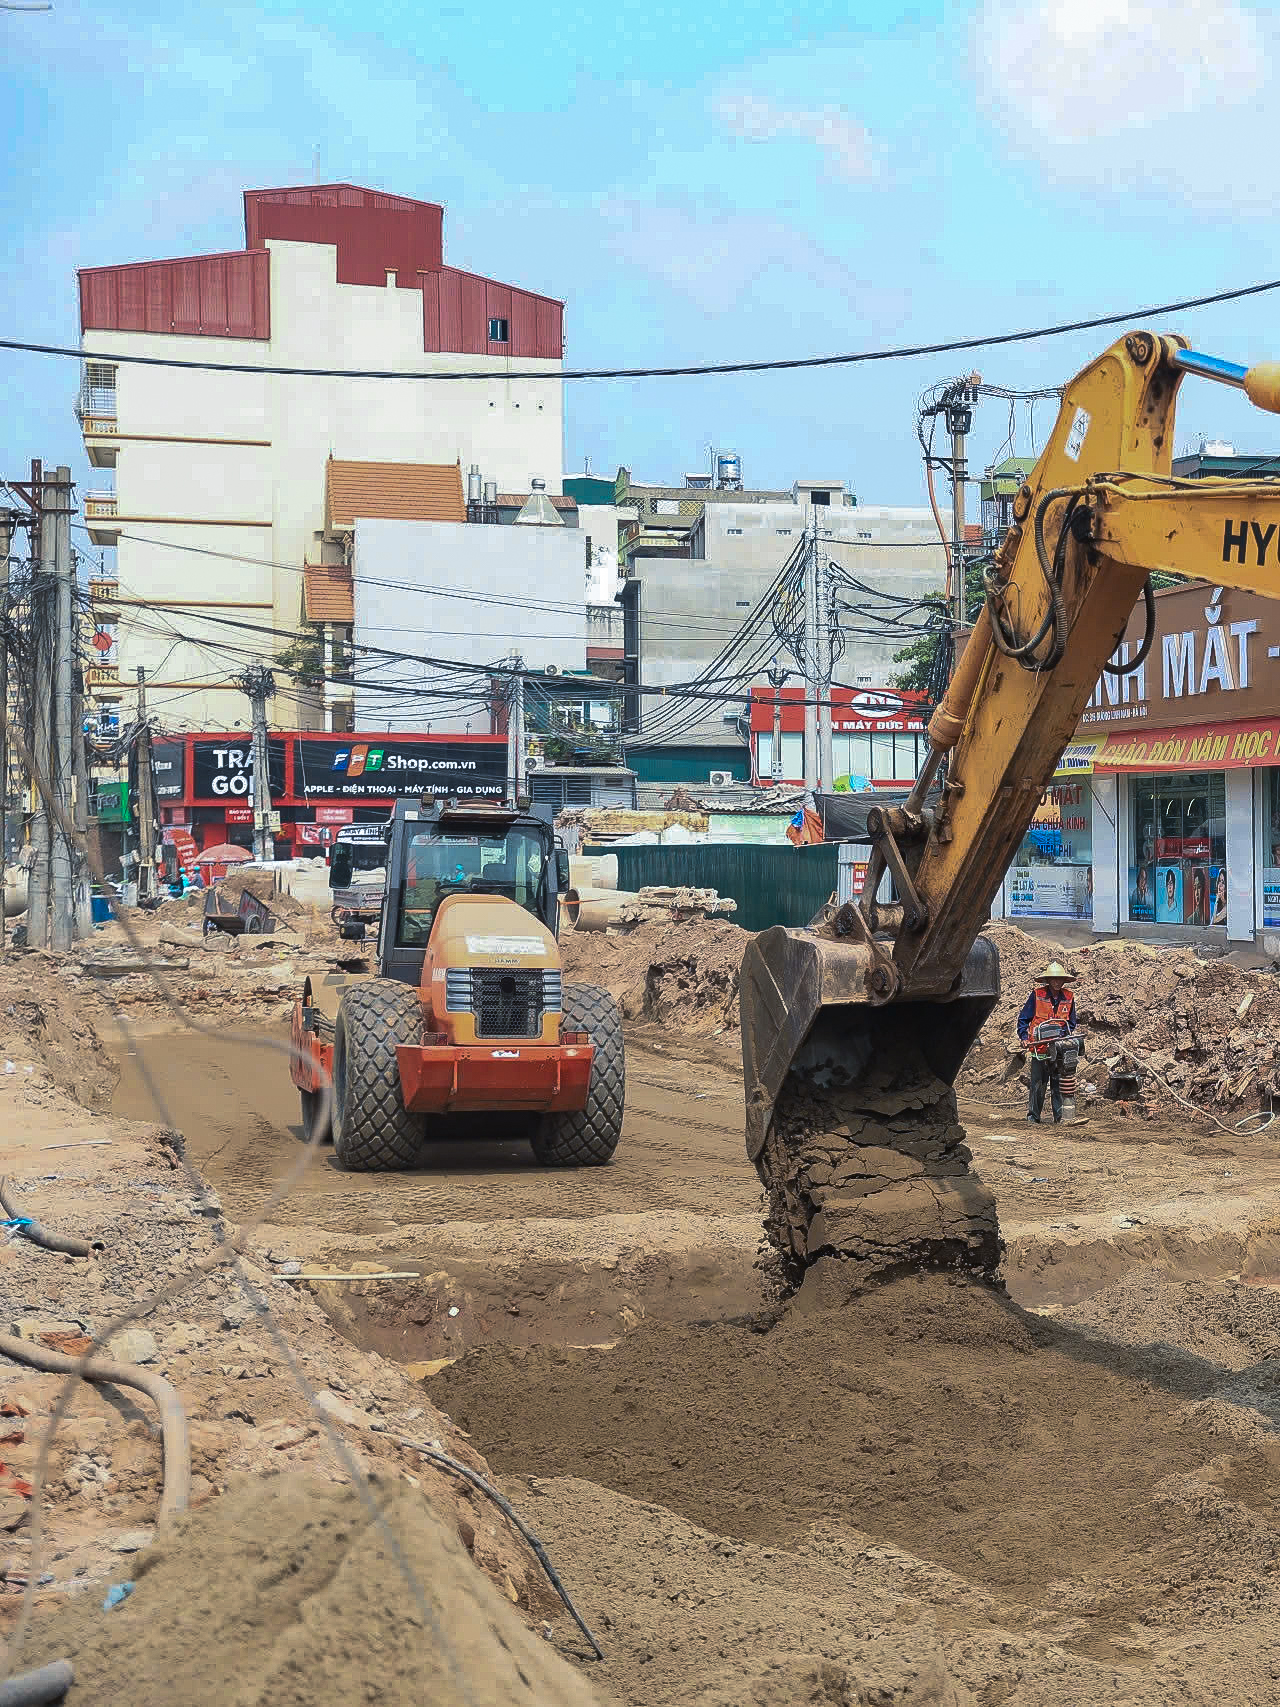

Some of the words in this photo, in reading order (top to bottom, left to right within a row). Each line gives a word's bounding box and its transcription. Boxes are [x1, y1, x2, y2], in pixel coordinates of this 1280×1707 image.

[1162, 586, 1257, 699] MẮT
[843, 720, 872, 730] MÁY
[876, 719, 904, 730] ĐỨC
[1187, 730, 1231, 763] NĂM
[1231, 730, 1272, 765] HỌC
[388, 756, 476, 772] Shop.com.vn
[304, 785, 334, 794] APPLE
[342, 784, 365, 795] ĐIỆN
[366, 785, 396, 795] THOẠI
[404, 783, 425, 794] MÁY
[425, 784, 449, 794] TÍNH
[456, 786, 473, 794] GIA
[475, 786, 503, 796] DỤNG
